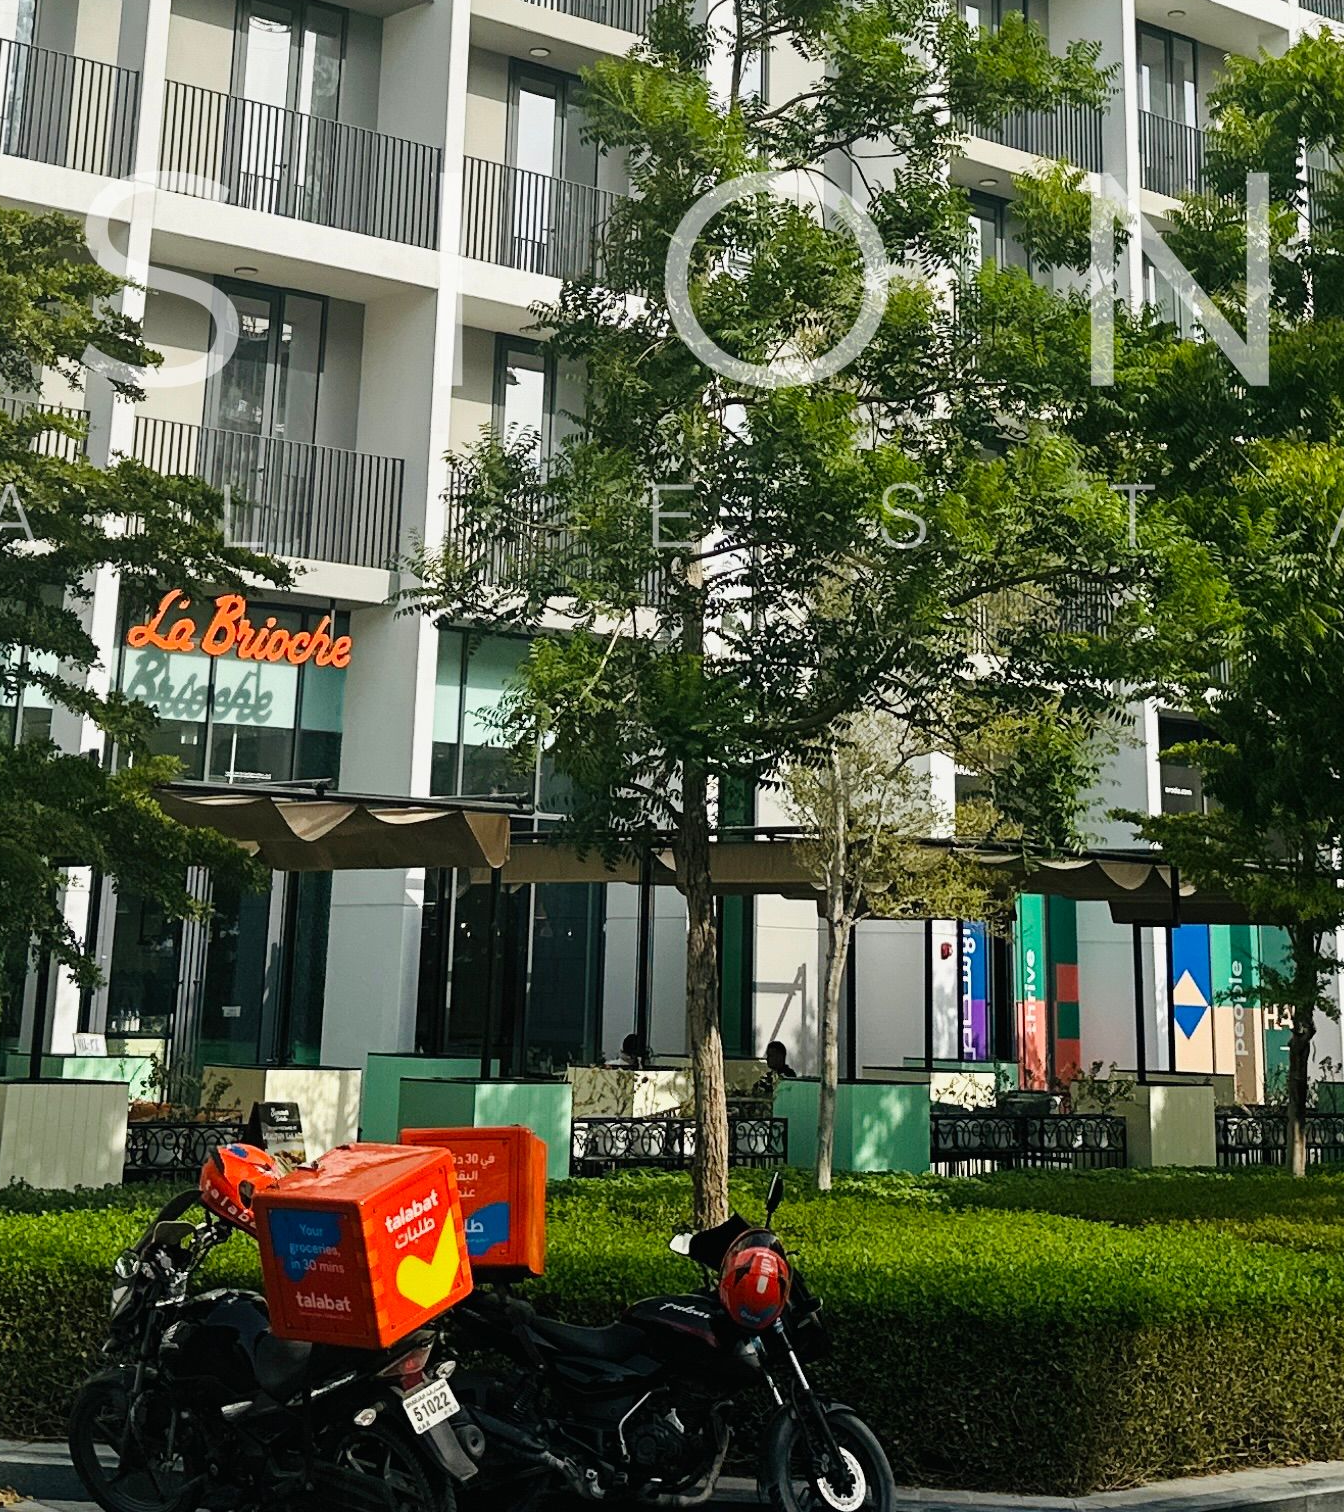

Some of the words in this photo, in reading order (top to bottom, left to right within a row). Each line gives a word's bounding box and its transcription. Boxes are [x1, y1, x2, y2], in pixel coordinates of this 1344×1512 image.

[201, 594, 352, 668] Brioche
[1024, 949, 1037, 1033] thrive
[465, 1153, 478, 1164] 30
[385, 1189, 439, 1234] talabat
[299, 1224, 323, 1236] Your
[395, 1217, 436, 1250] طلبات
[289, 1243, 341, 1257] groceries,
[290, 1257, 301, 1270] in
[303, 1258, 317, 1270] 30
[319, 1261, 345, 1274] mins
[296, 1291, 352, 1312] talabat
[413, 1391, 451, 1422] 51022
